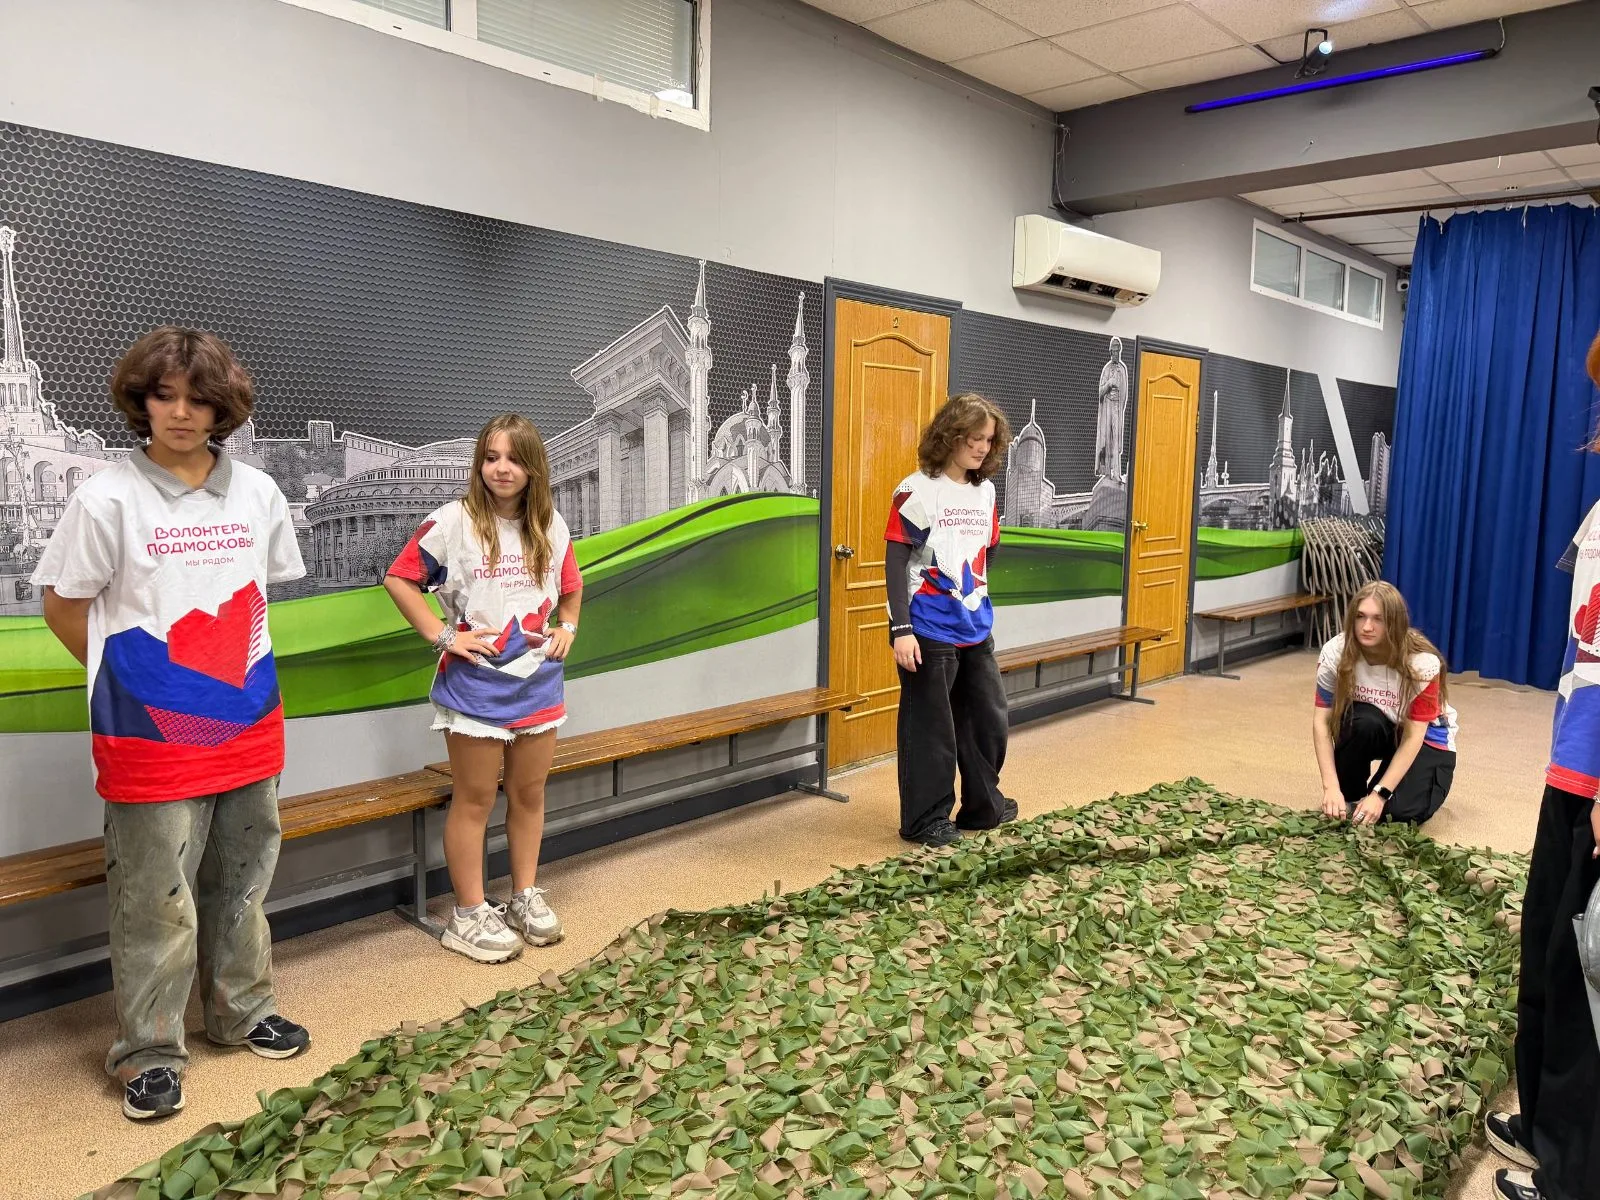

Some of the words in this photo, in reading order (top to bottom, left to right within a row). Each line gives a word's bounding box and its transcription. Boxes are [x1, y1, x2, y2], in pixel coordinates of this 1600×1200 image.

[892, 316, 899, 328] 2
[155, 523, 249, 540] ВОЛОНТЕРЫ
[185, 559, 200, 567] МЫ
[203, 556, 234, 566] РЯДОМ
[514, 579, 537, 588] РЯДО
